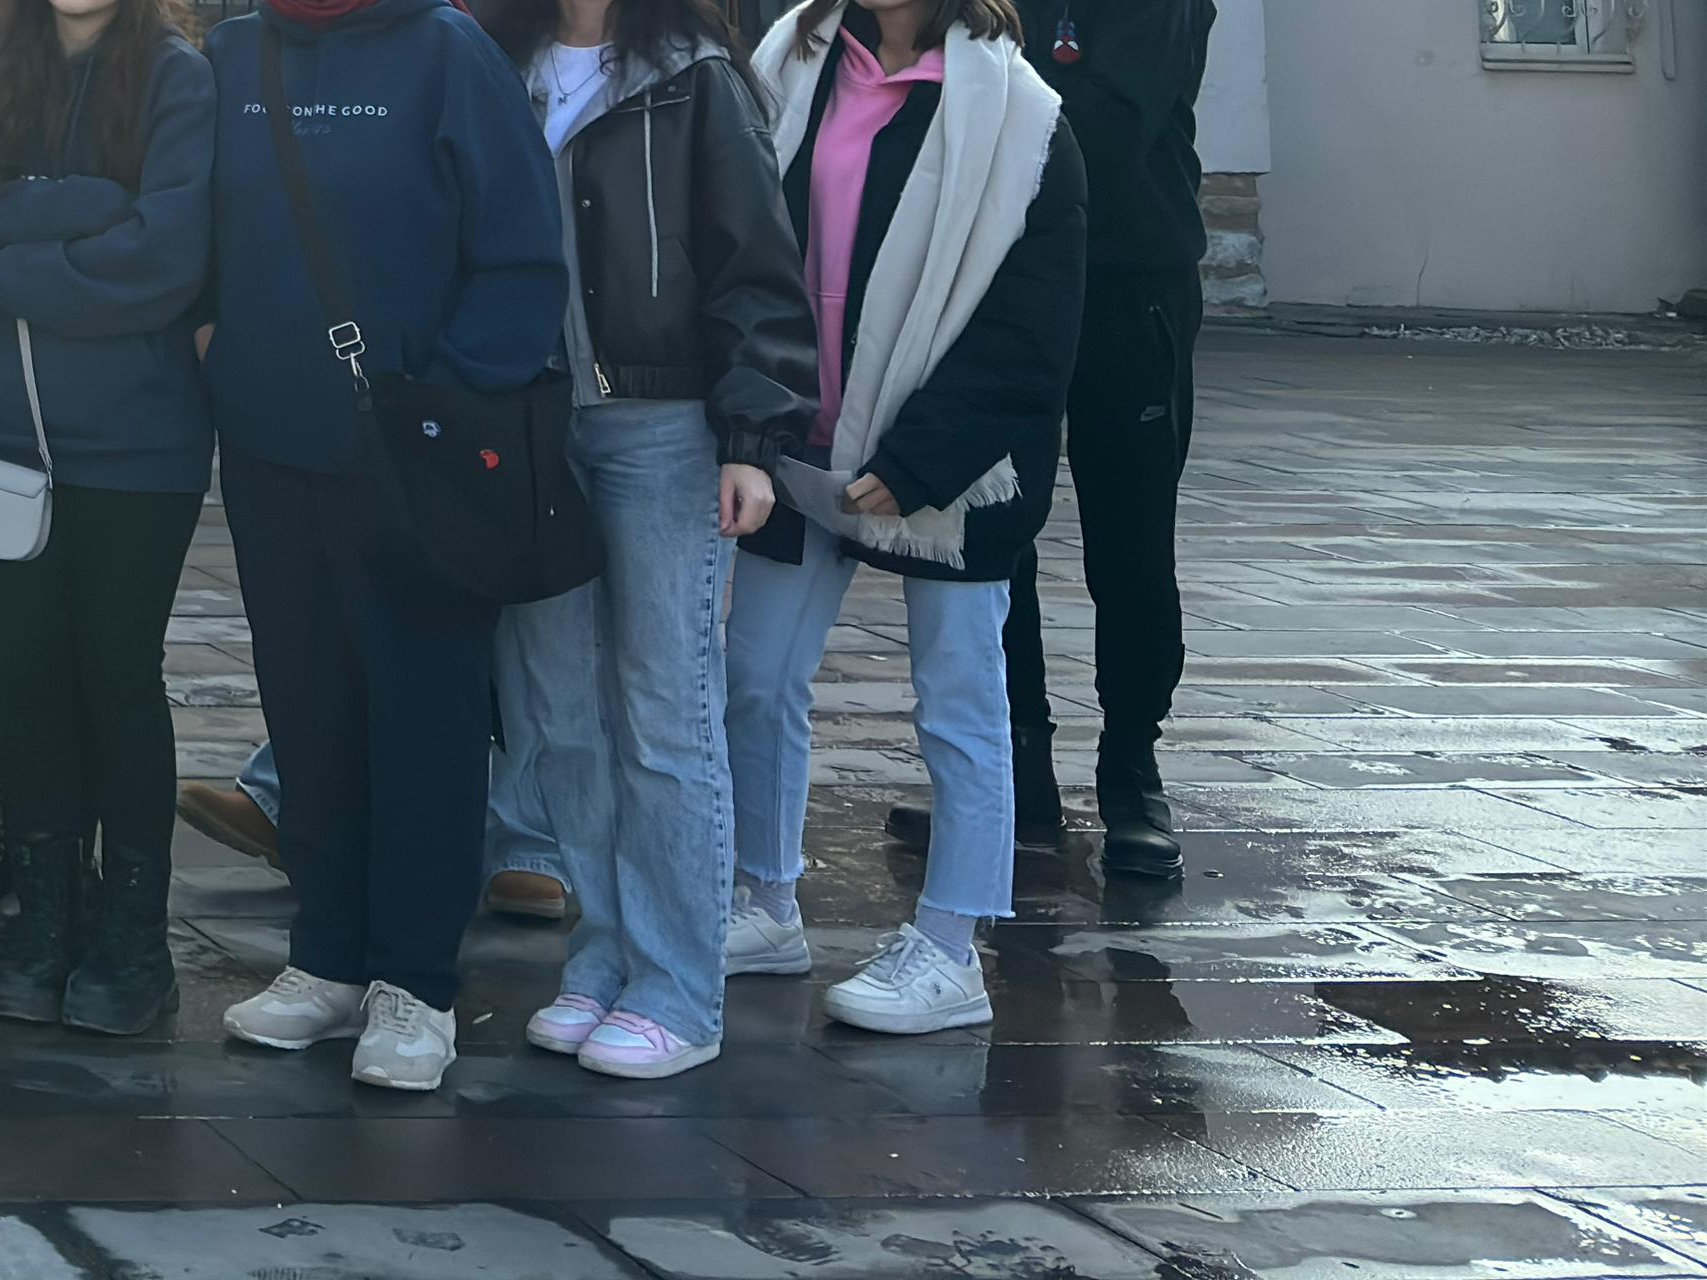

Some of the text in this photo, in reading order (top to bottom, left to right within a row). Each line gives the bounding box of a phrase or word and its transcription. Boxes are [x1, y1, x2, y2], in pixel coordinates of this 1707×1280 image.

[292, 106, 313, 117] ON
[315, 104, 337, 116] HE
[341, 105, 388, 117] GOOD
